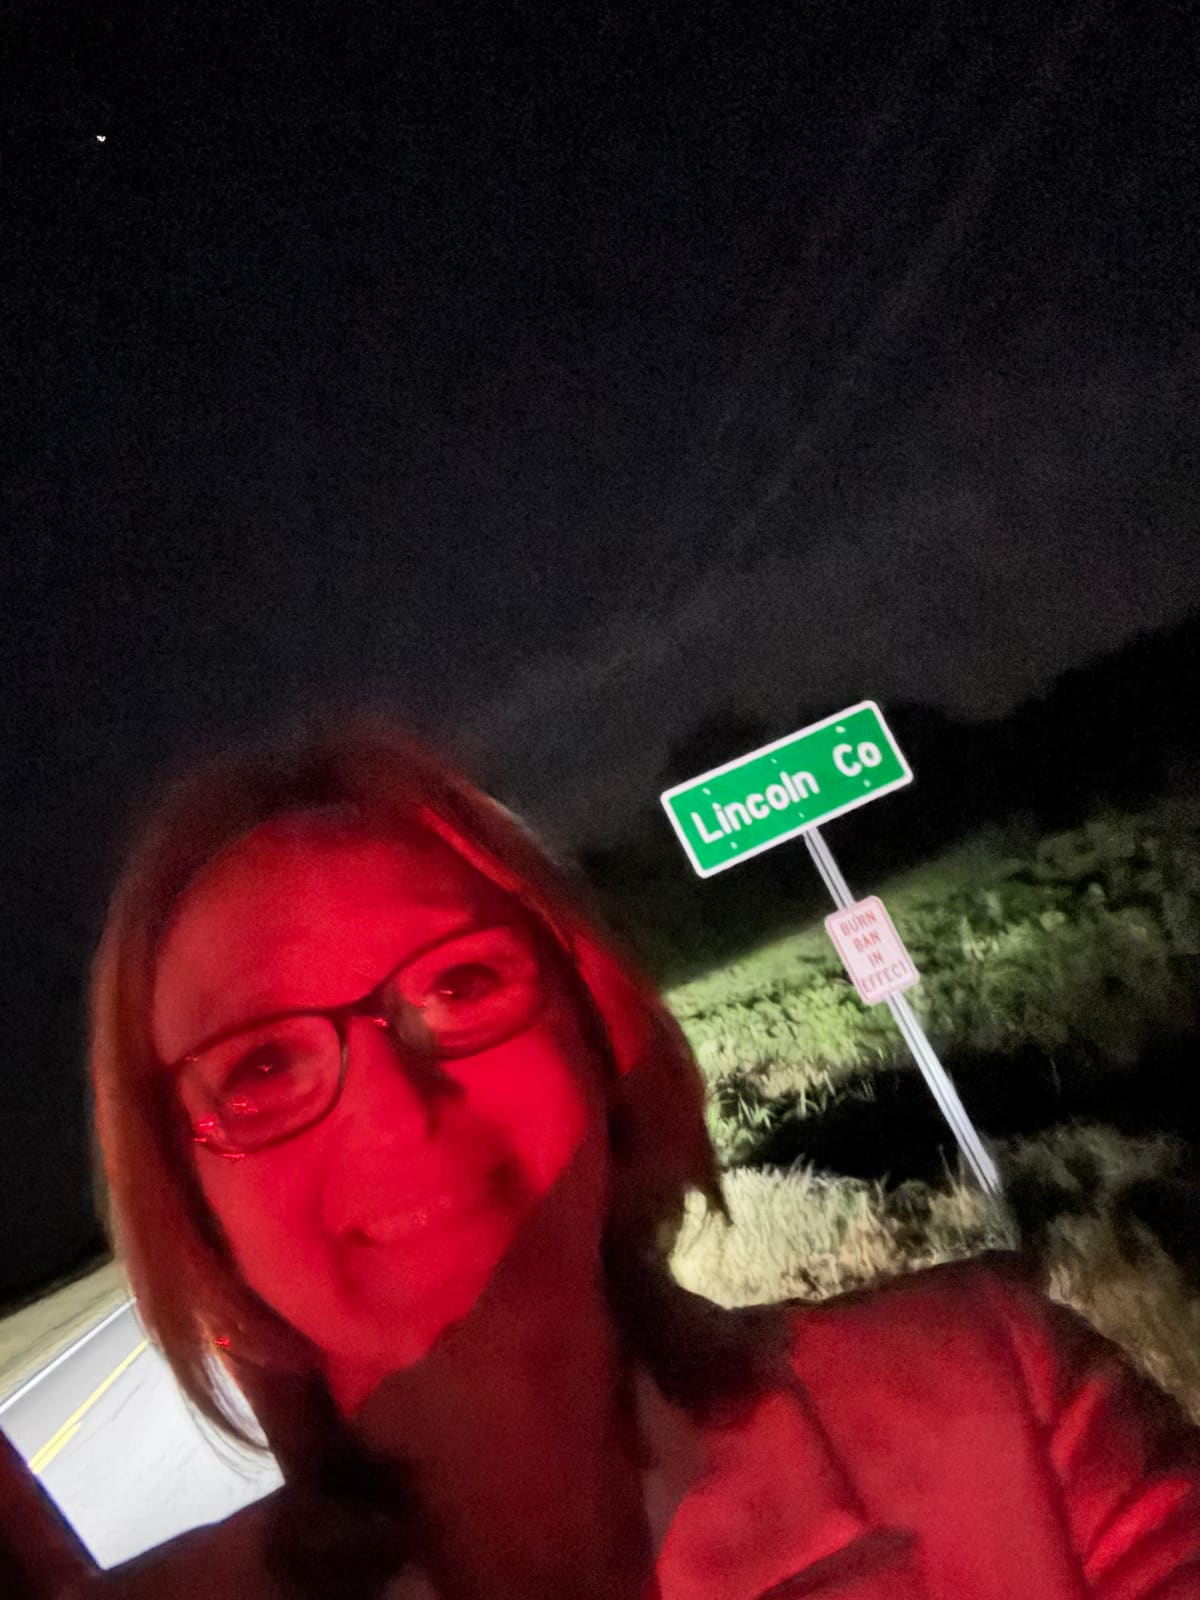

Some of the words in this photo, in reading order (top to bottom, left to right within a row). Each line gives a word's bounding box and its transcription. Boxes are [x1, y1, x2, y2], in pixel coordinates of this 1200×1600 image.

[691, 771, 820, 844] Lincoln
[832, 741, 882, 777] Co
[840, 910, 877, 936] BURN
[853, 930, 881, 952] BAN
[867, 950, 885, 968] IN
